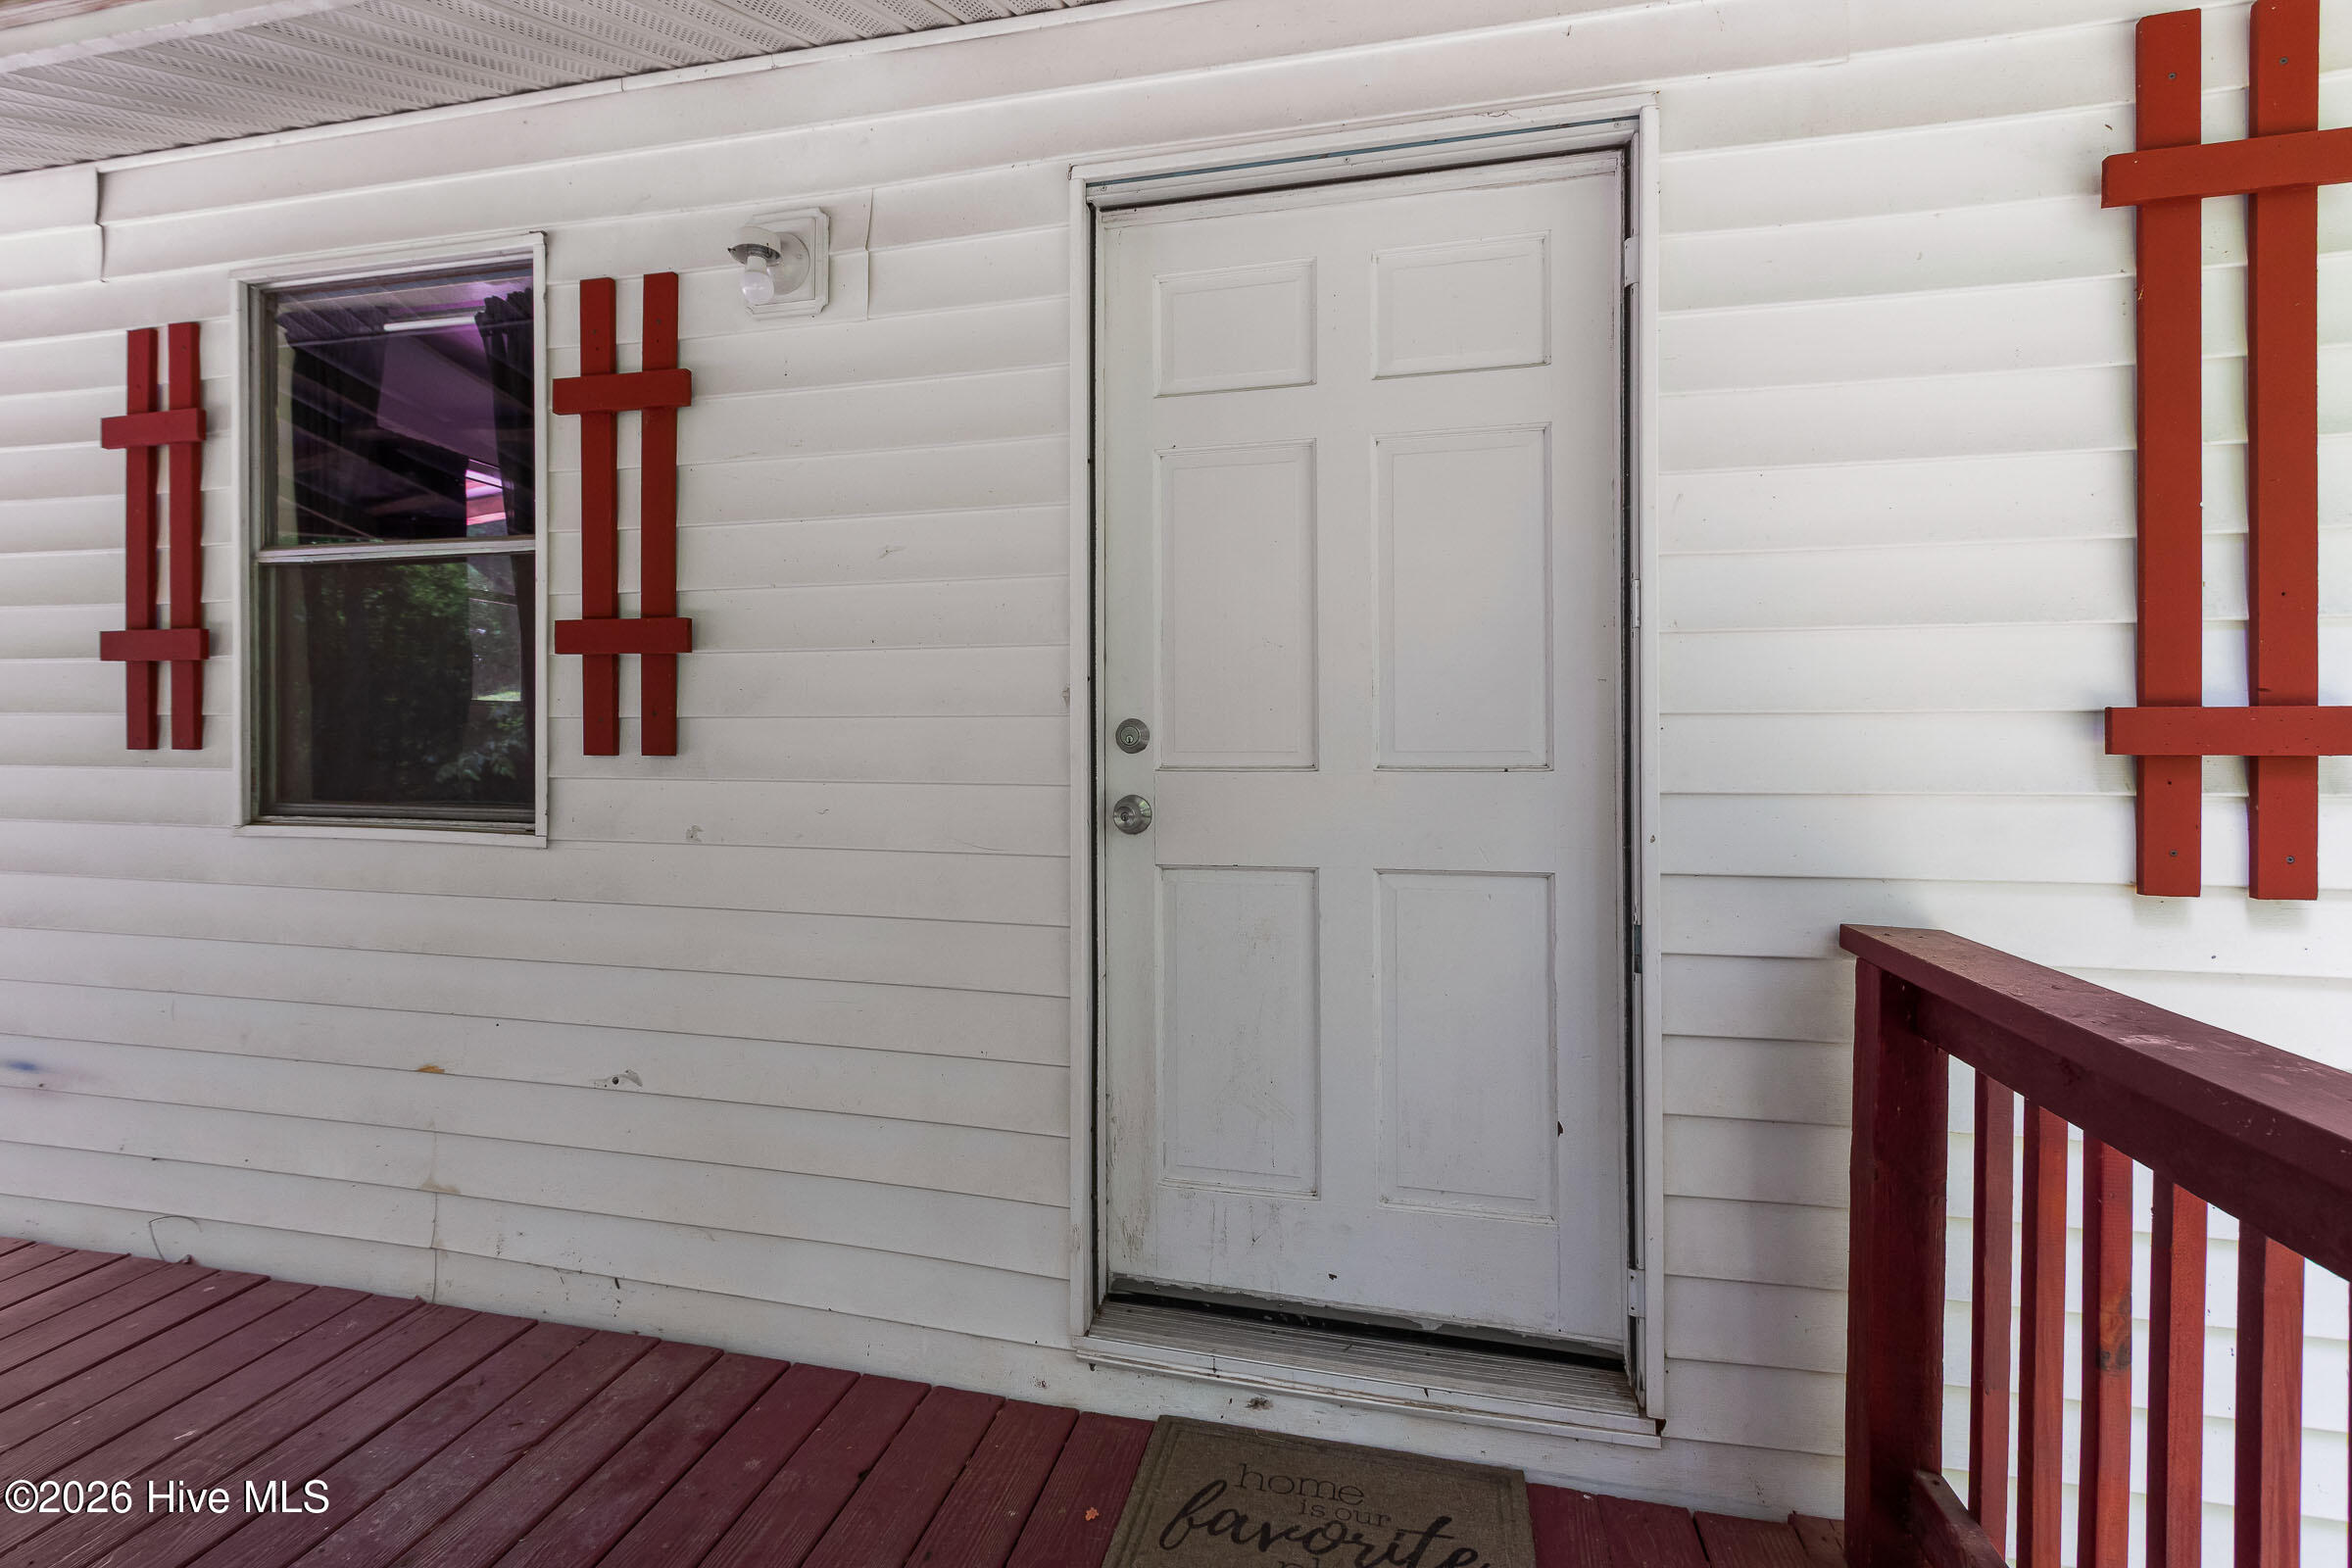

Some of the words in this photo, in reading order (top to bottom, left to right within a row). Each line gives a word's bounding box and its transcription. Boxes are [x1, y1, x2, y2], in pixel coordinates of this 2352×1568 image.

[1232, 1462, 1365, 1506] home
[1298, 1498, 1327, 1519] is
[1334, 1506, 1393, 1528] our
